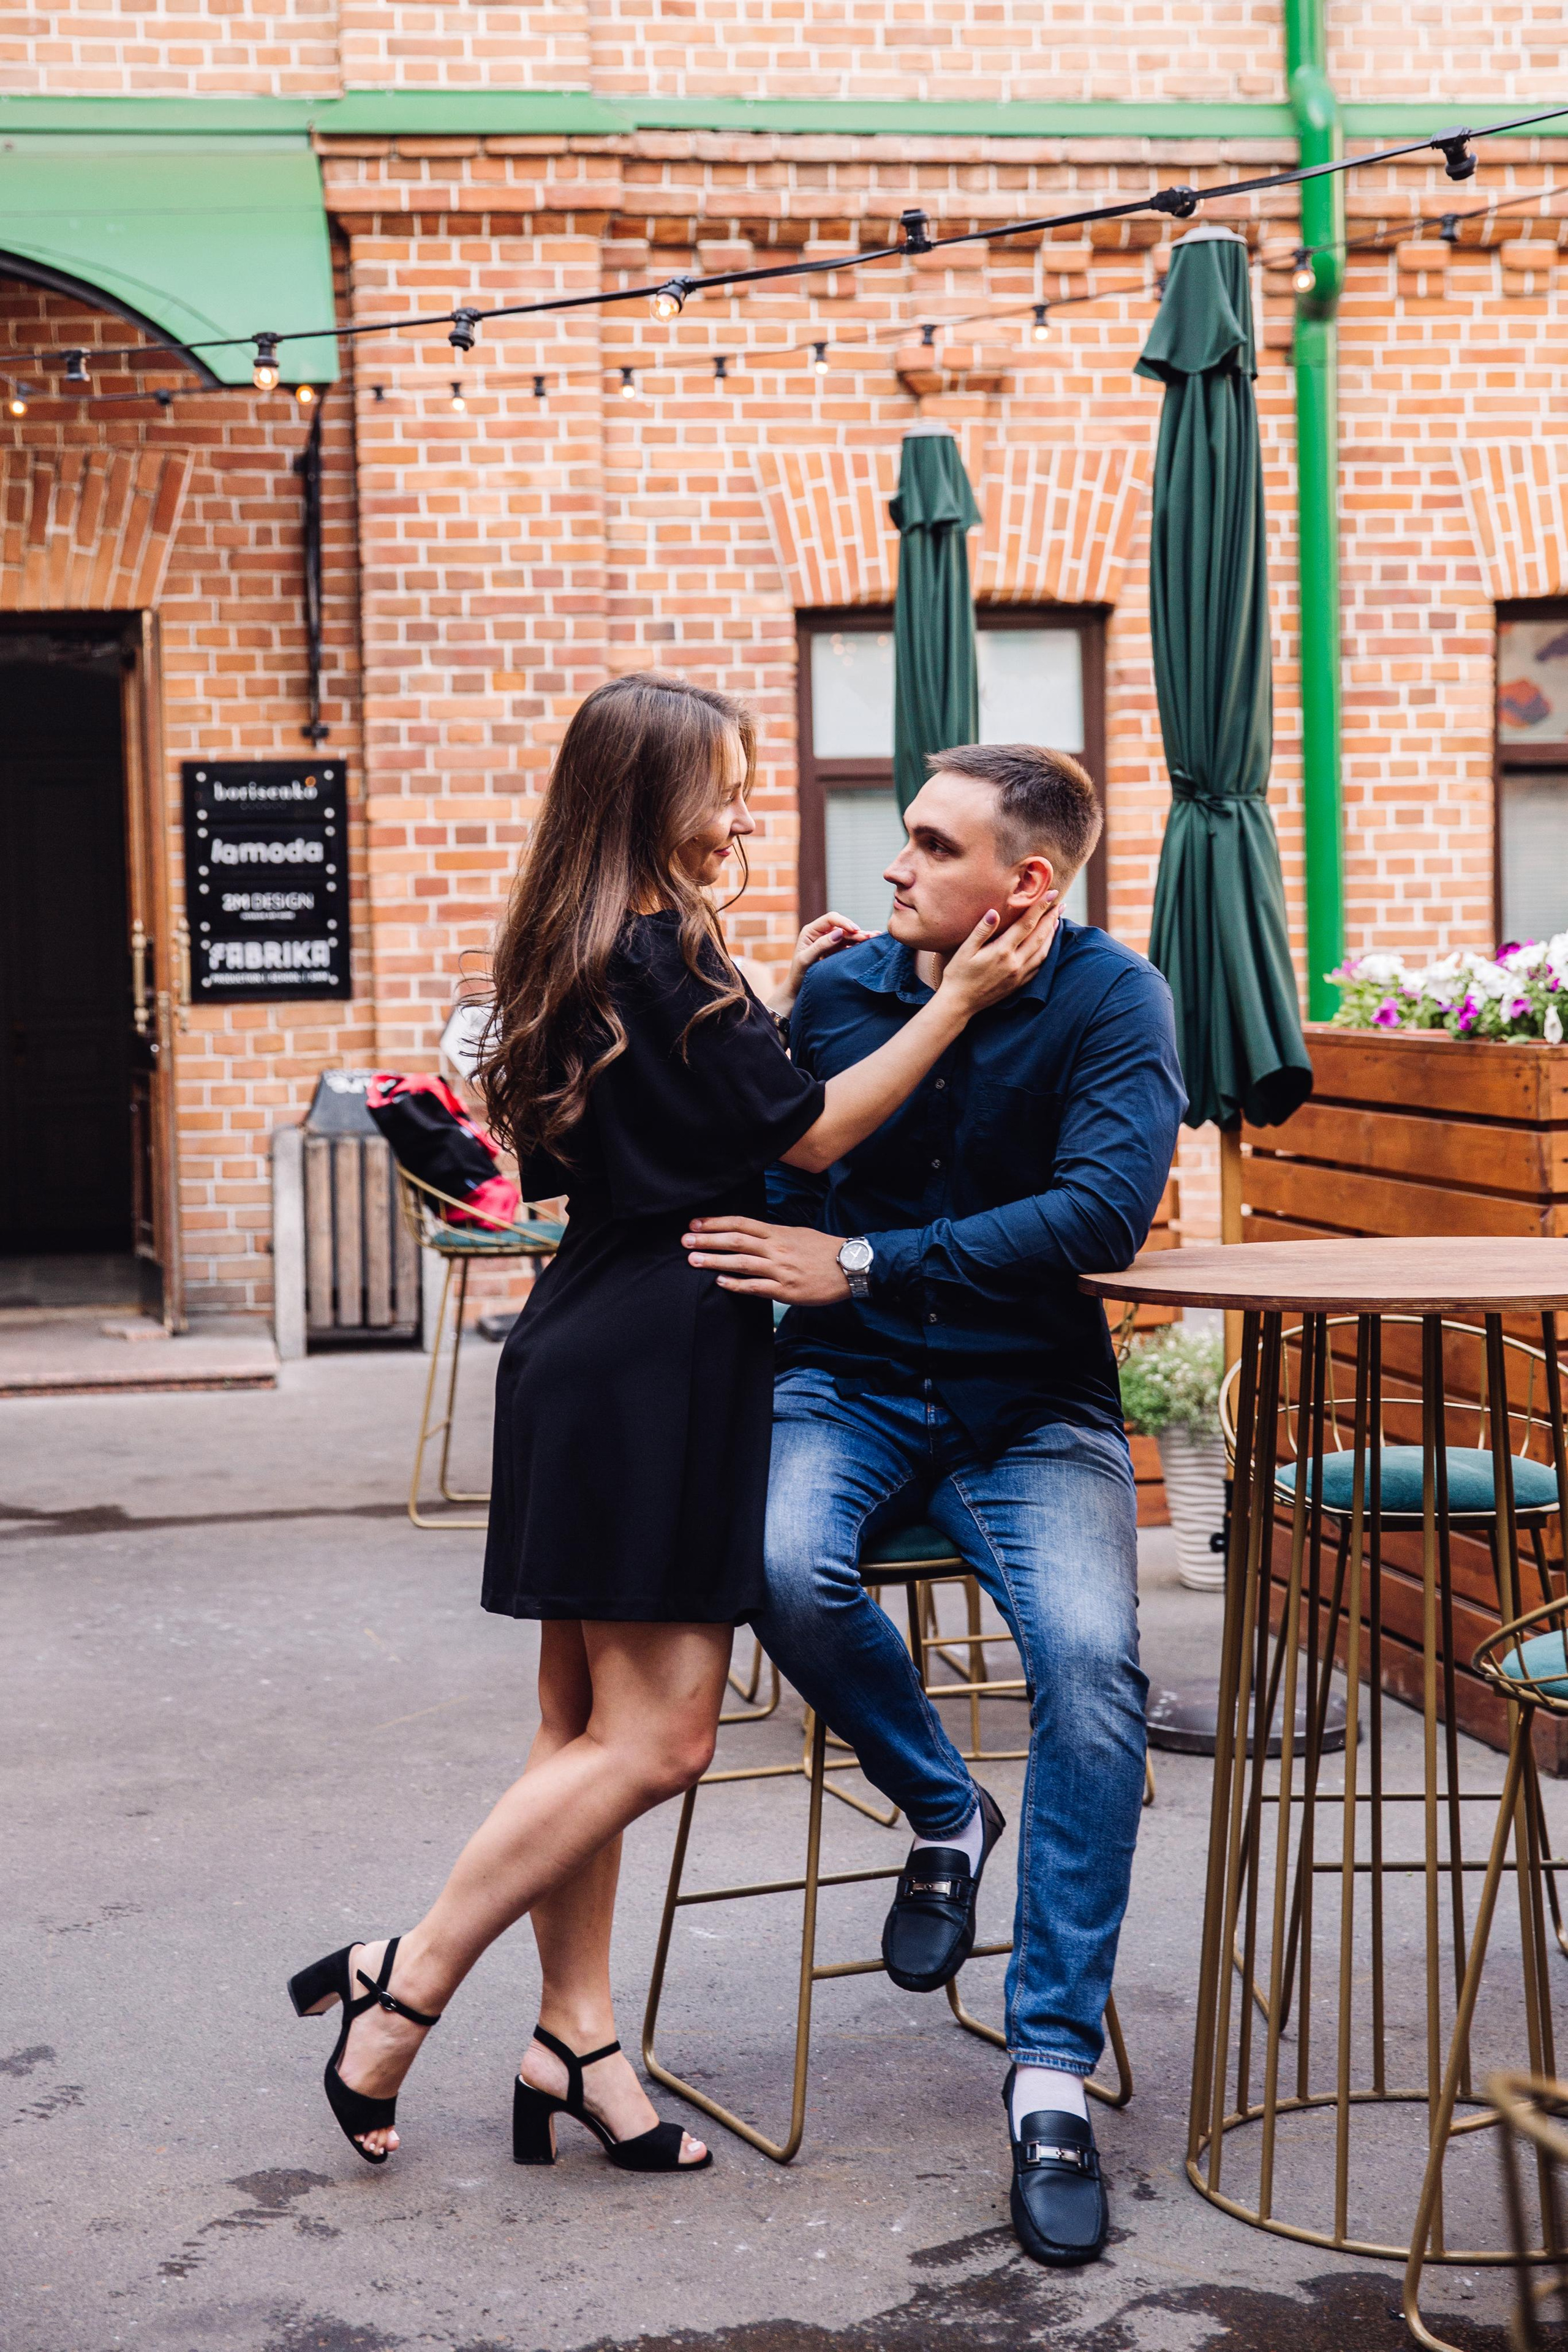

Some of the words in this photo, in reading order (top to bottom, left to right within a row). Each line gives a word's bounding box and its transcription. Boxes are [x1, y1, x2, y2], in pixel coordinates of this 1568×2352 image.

[214, 780, 318, 801] borisenko
[211, 838, 324, 865] lamoda
[251, 892, 315, 911] DESIGN
[209, 940, 330, 970] FABRIKA
